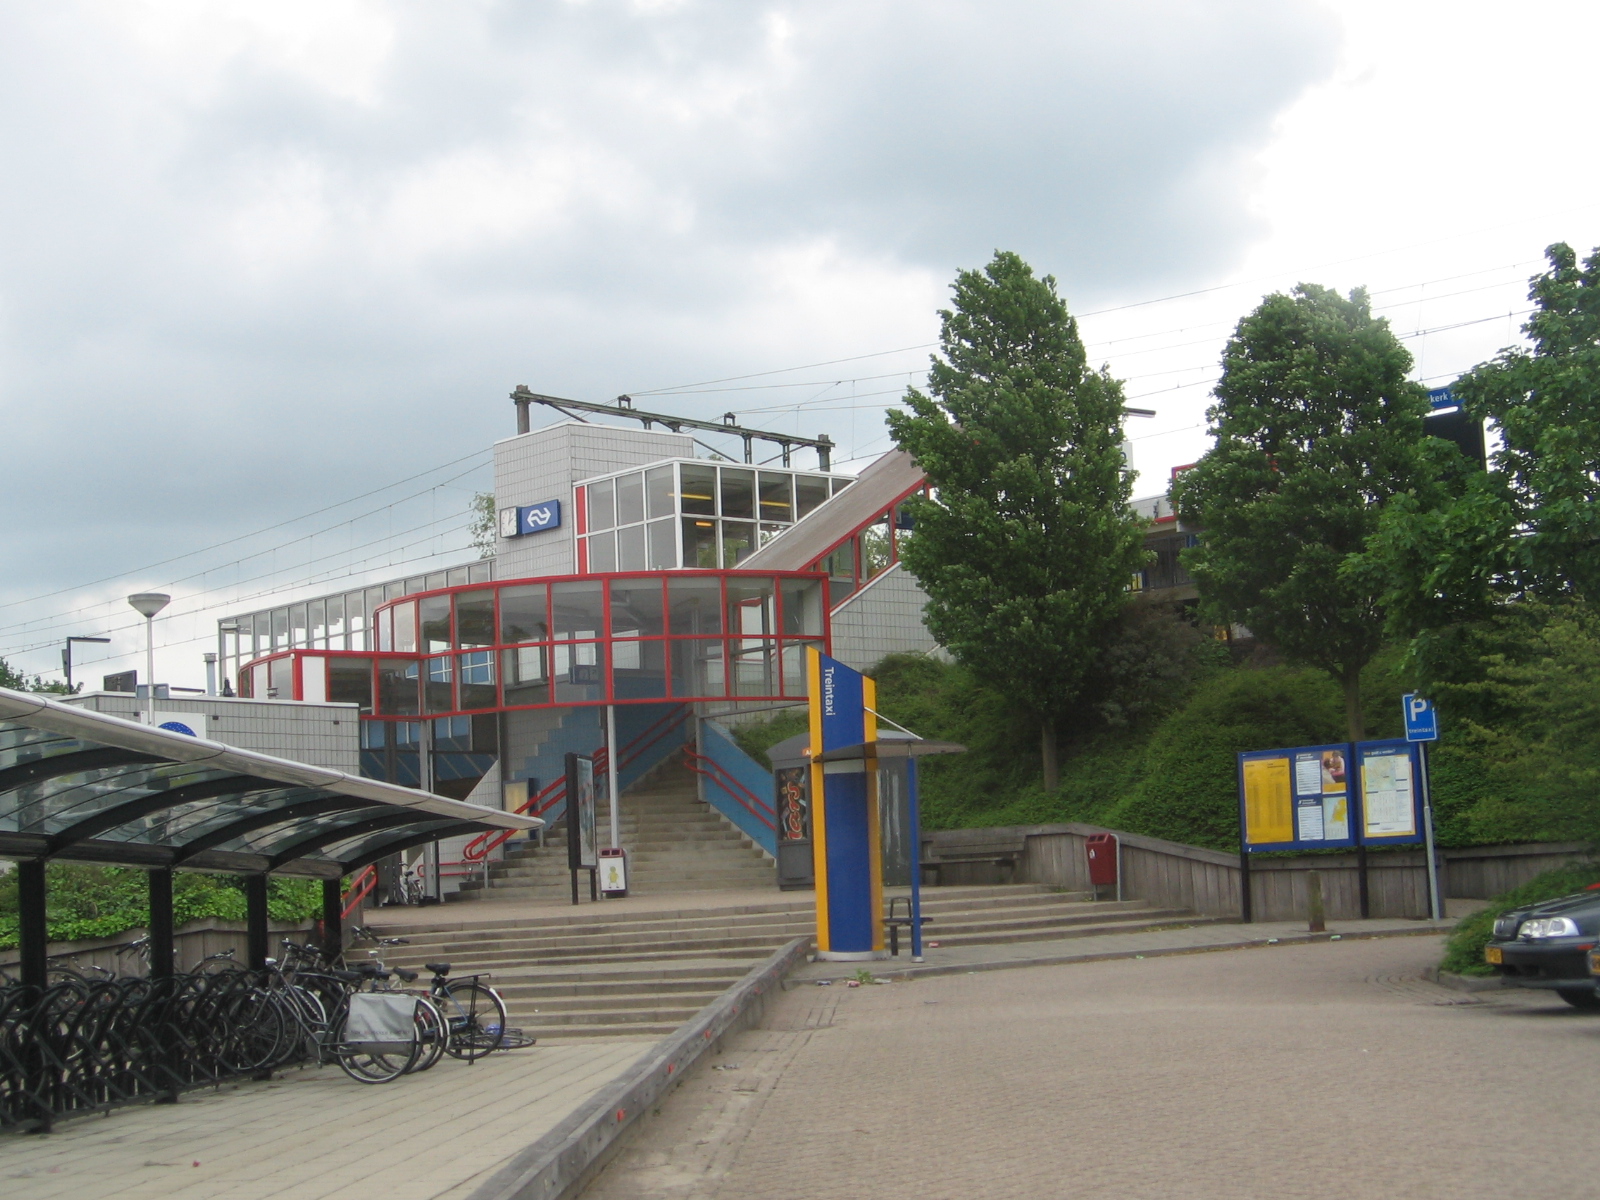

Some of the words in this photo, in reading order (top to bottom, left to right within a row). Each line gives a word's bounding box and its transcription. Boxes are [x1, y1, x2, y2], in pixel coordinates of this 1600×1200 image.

[1430, 392, 1449, 403] kerk
[824, 666, 836, 716] Treintaxi
[1411, 698, 1427, 721] P
